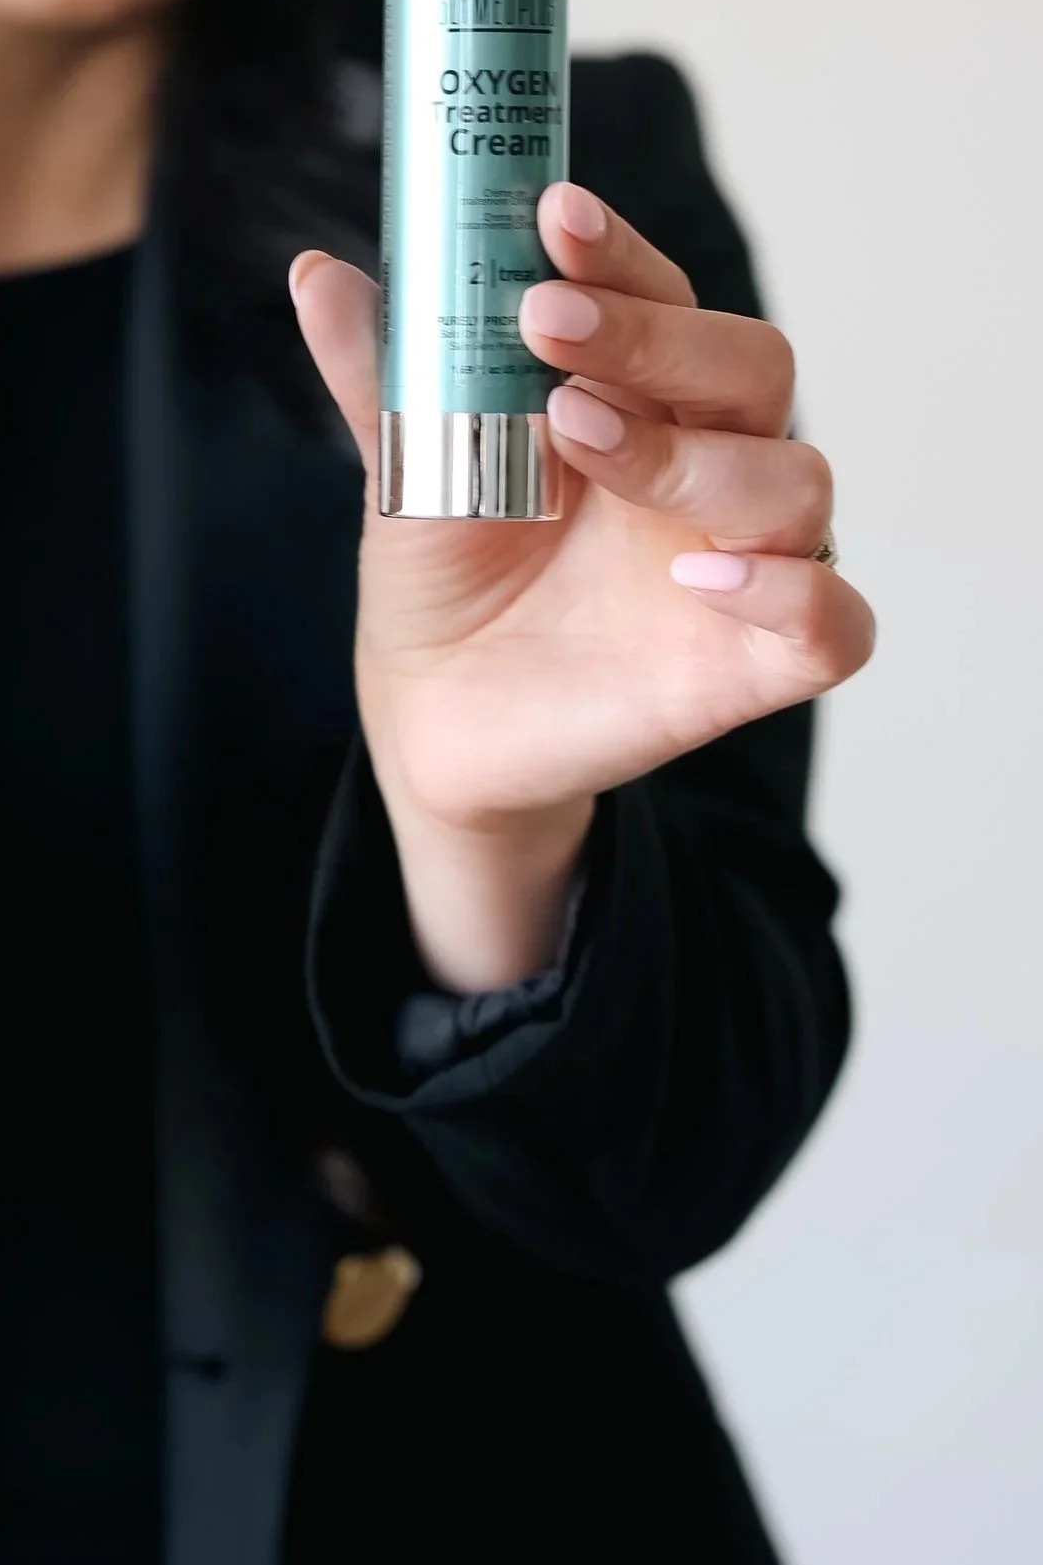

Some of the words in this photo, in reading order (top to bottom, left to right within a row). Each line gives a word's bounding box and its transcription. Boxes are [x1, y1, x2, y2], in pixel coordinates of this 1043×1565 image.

[440, 68, 558, 96] OXYGEN
[430, 101, 563, 125] Treatment
[449, 128, 552, 157] Cream
[468, 260, 487, 286] 2
